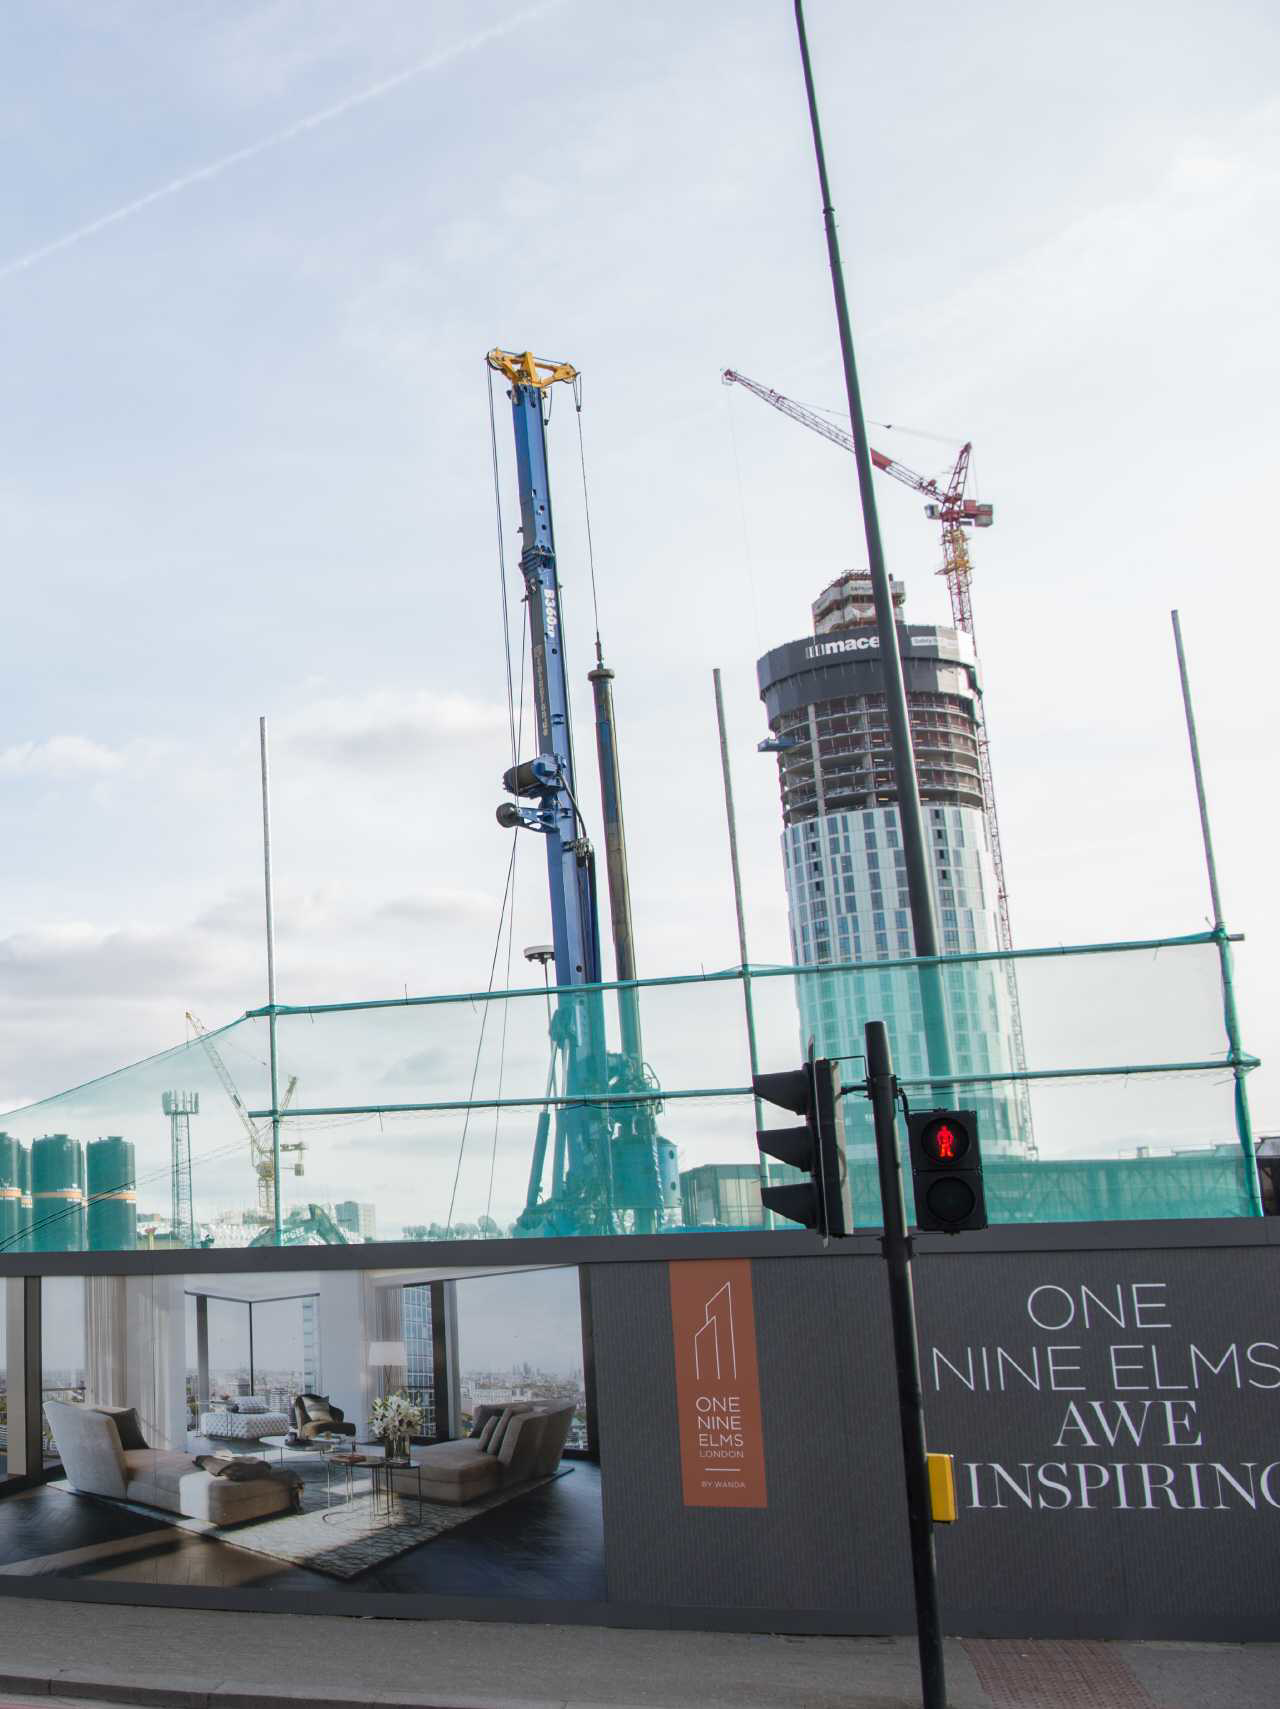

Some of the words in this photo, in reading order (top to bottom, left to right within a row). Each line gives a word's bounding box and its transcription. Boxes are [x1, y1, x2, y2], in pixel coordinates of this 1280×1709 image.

[1027, 1283, 1172, 1331] ONE
[932, 1345, 1086, 1391] NINE
[1110, 1342, 1280, 1389] ELMS
[695, 1396, 741, 1413] ONE
[697, 1416, 742, 1430] NINE
[1053, 1400, 1203, 1447] AWE
[699, 1433, 744, 1447] ELMS
[699, 1450, 744, 1459] LONDON
